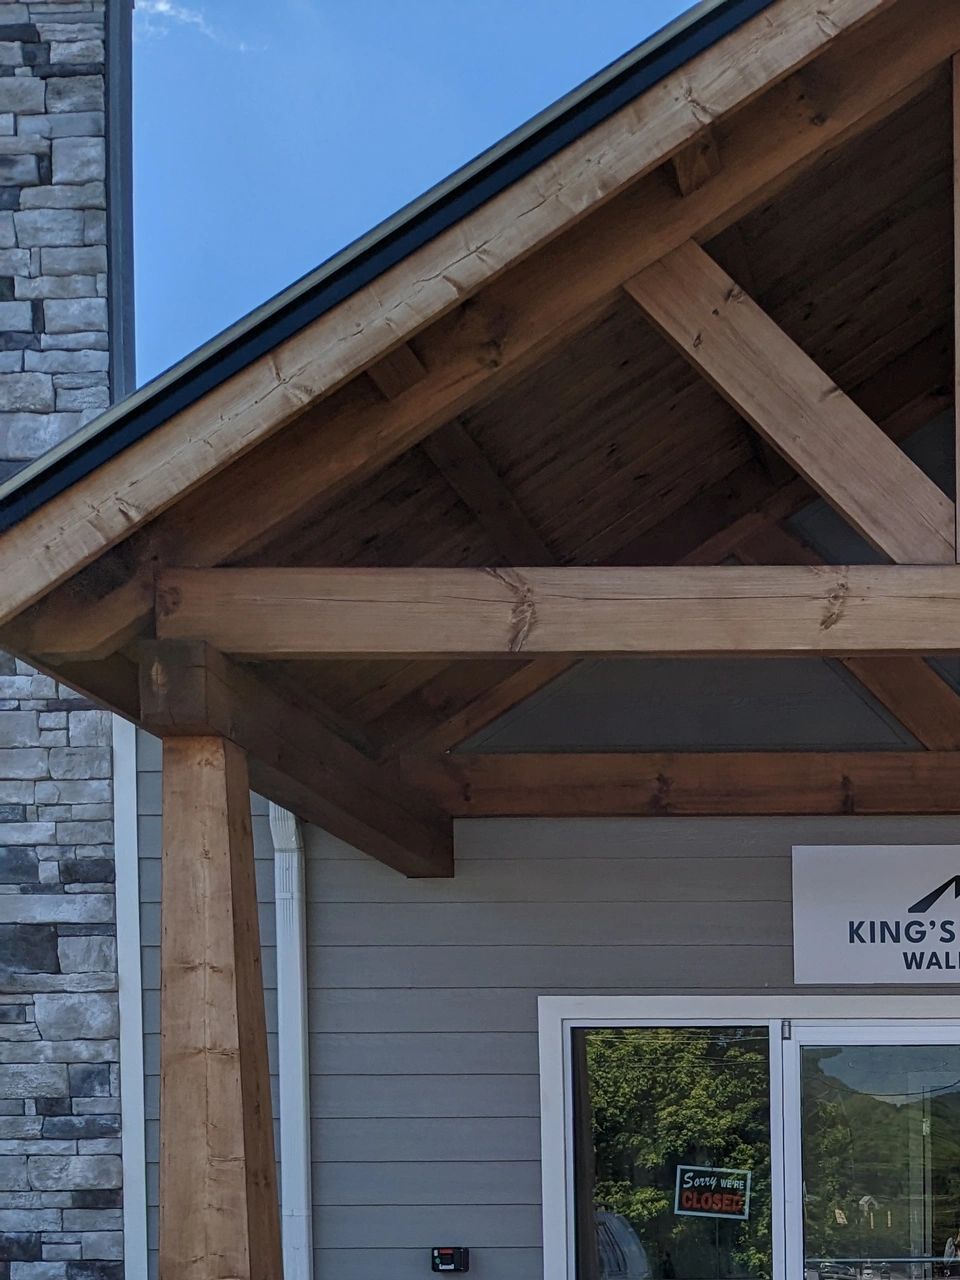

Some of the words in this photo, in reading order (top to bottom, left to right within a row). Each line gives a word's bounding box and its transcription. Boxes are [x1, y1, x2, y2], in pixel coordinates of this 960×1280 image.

[848, 919, 956, 944] KING'S
[683, 1171, 717, 1190] Sorry
[720, 1178, 745, 1189] WE'RE
[681, 1189, 744, 1213] CLOSED
